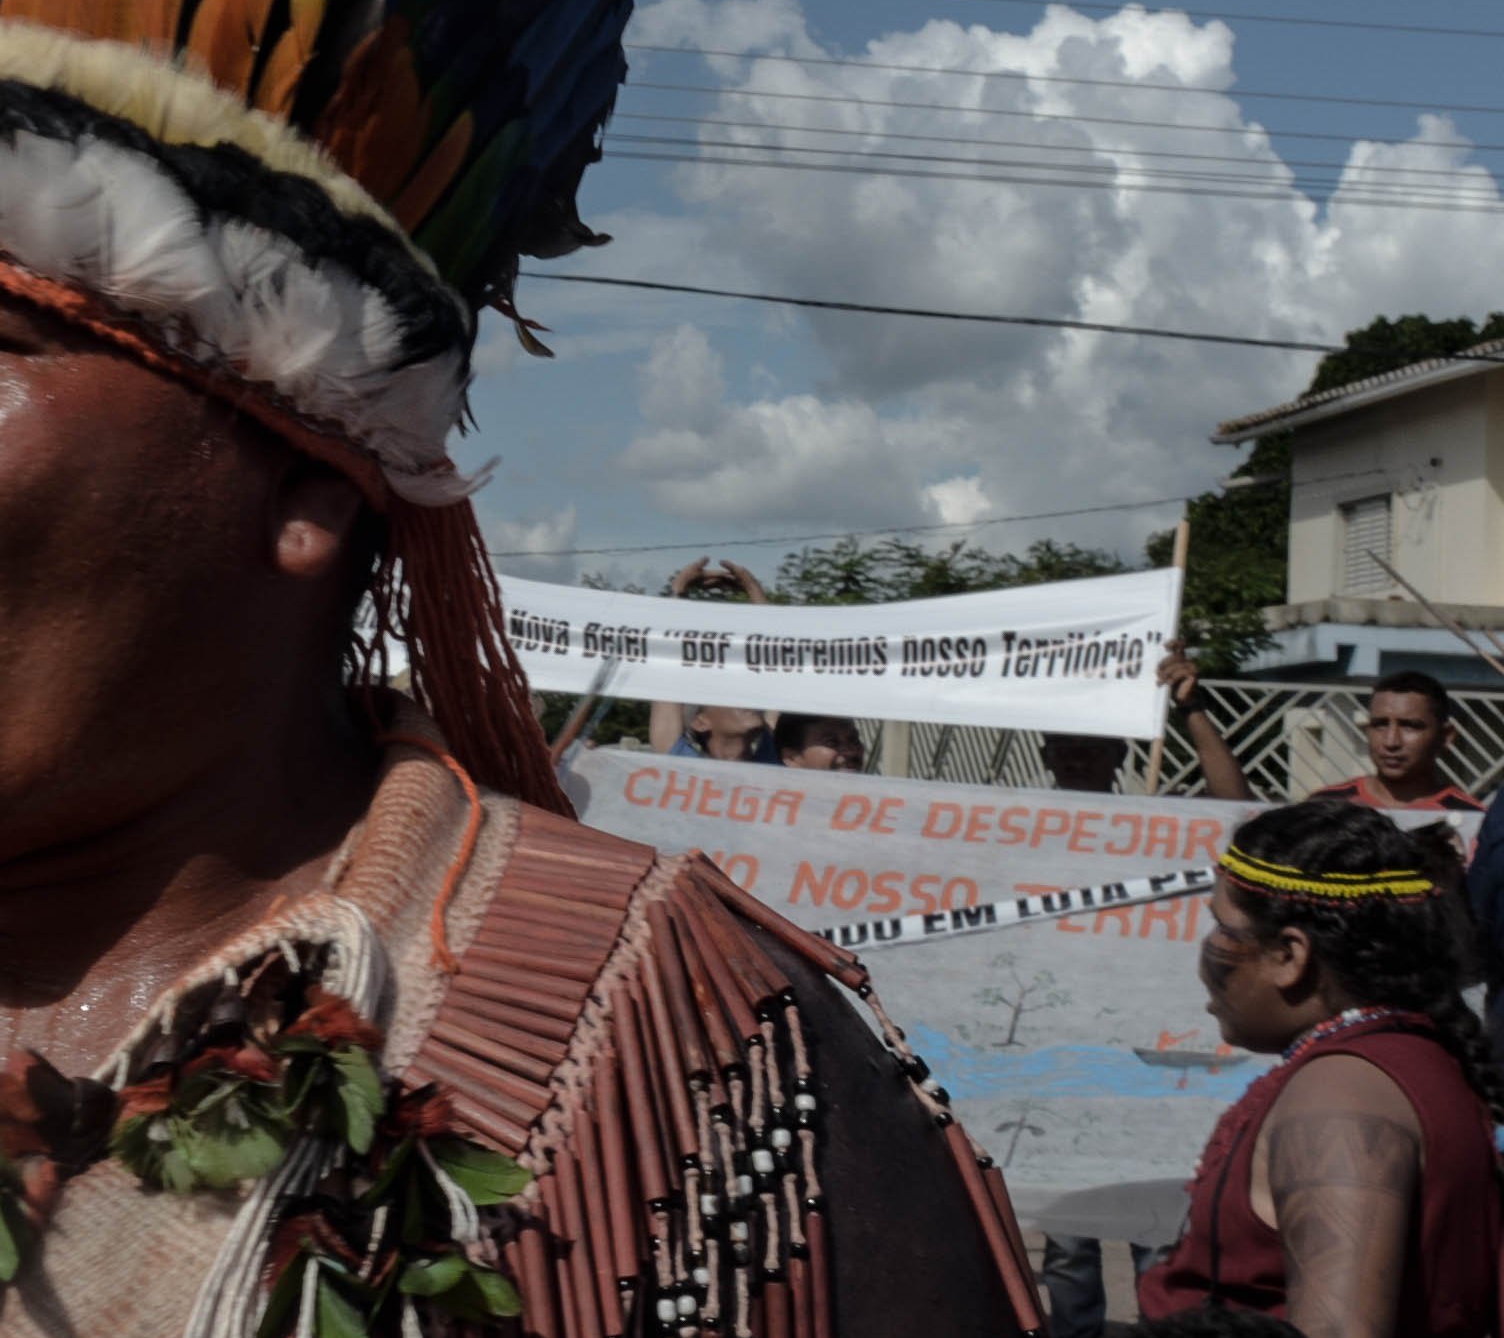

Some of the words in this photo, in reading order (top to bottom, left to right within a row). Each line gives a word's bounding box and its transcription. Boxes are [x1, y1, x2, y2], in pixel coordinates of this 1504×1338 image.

[745, 633, 889, 676] Queremos
[624, 767, 805, 827] CHEGA
[830, 793, 906, 834] DE
[921, 801, 1224, 862] DESPEJAR
[788, 860, 980, 916] NOSSO
